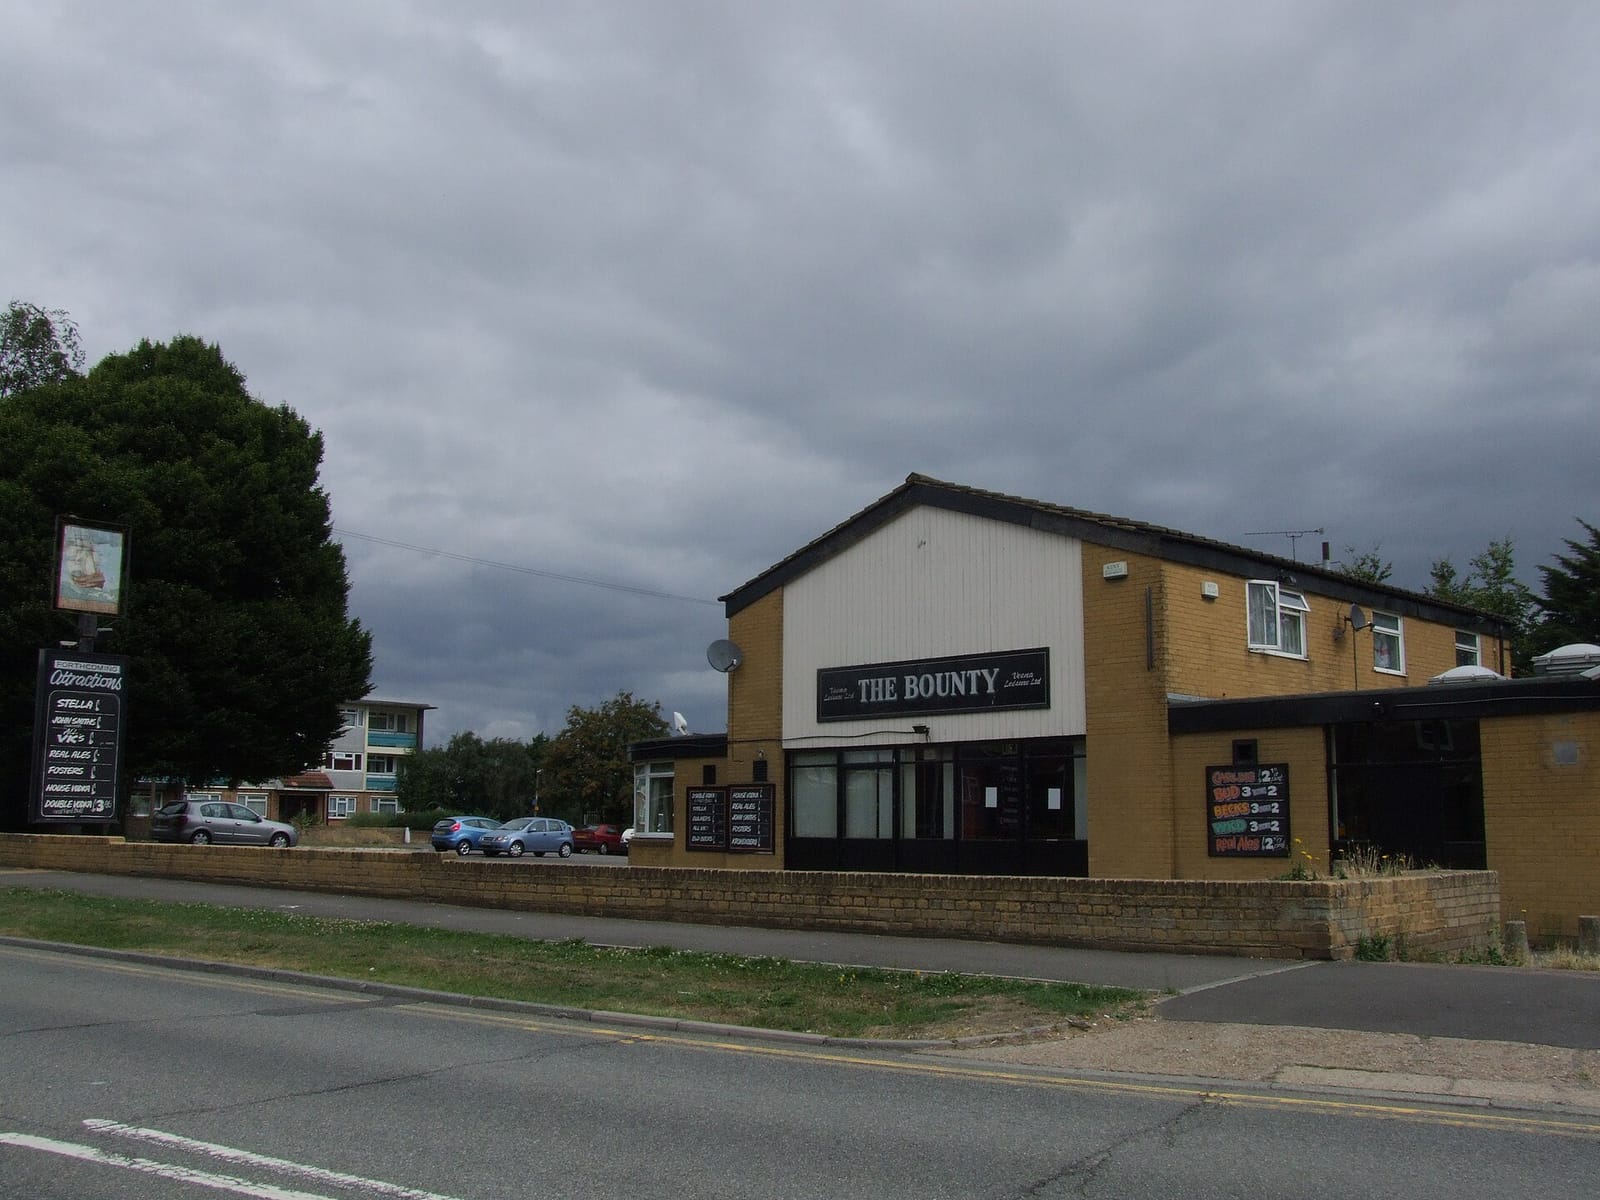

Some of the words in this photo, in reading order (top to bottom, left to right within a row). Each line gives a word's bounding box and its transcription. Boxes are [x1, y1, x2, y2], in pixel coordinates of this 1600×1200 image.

[57, 662, 119, 672] FORTHCOMING
[857, 677, 898, 704] THE
[903, 668, 1000, 700] BOUNTY
[57, 699, 94, 709] STELLA
[52, 717, 72, 725] JOHN
[49, 750, 69, 758] REAL
[71, 751, 92, 759] ALES
[48, 766, 84, 775] FOSTERS
[46, 784, 71, 793] HOUSE
[72, 785, 91, 793] VODKA
[1214, 786, 1241, 802] BUD
[1242, 787, 1252, 798] 3
[1268, 786, 1278, 796] 2
[45, 800, 73, 809] DOUBLE
[74, 801, 93, 809] VODKA
[1214, 802, 1251, 818] BECKS
[1251, 803, 1260, 814] 3
[1272, 803, 1280, 814] 2
[1250, 821, 1259, 832] 3
[1271, 821, 1280, 832] 2
